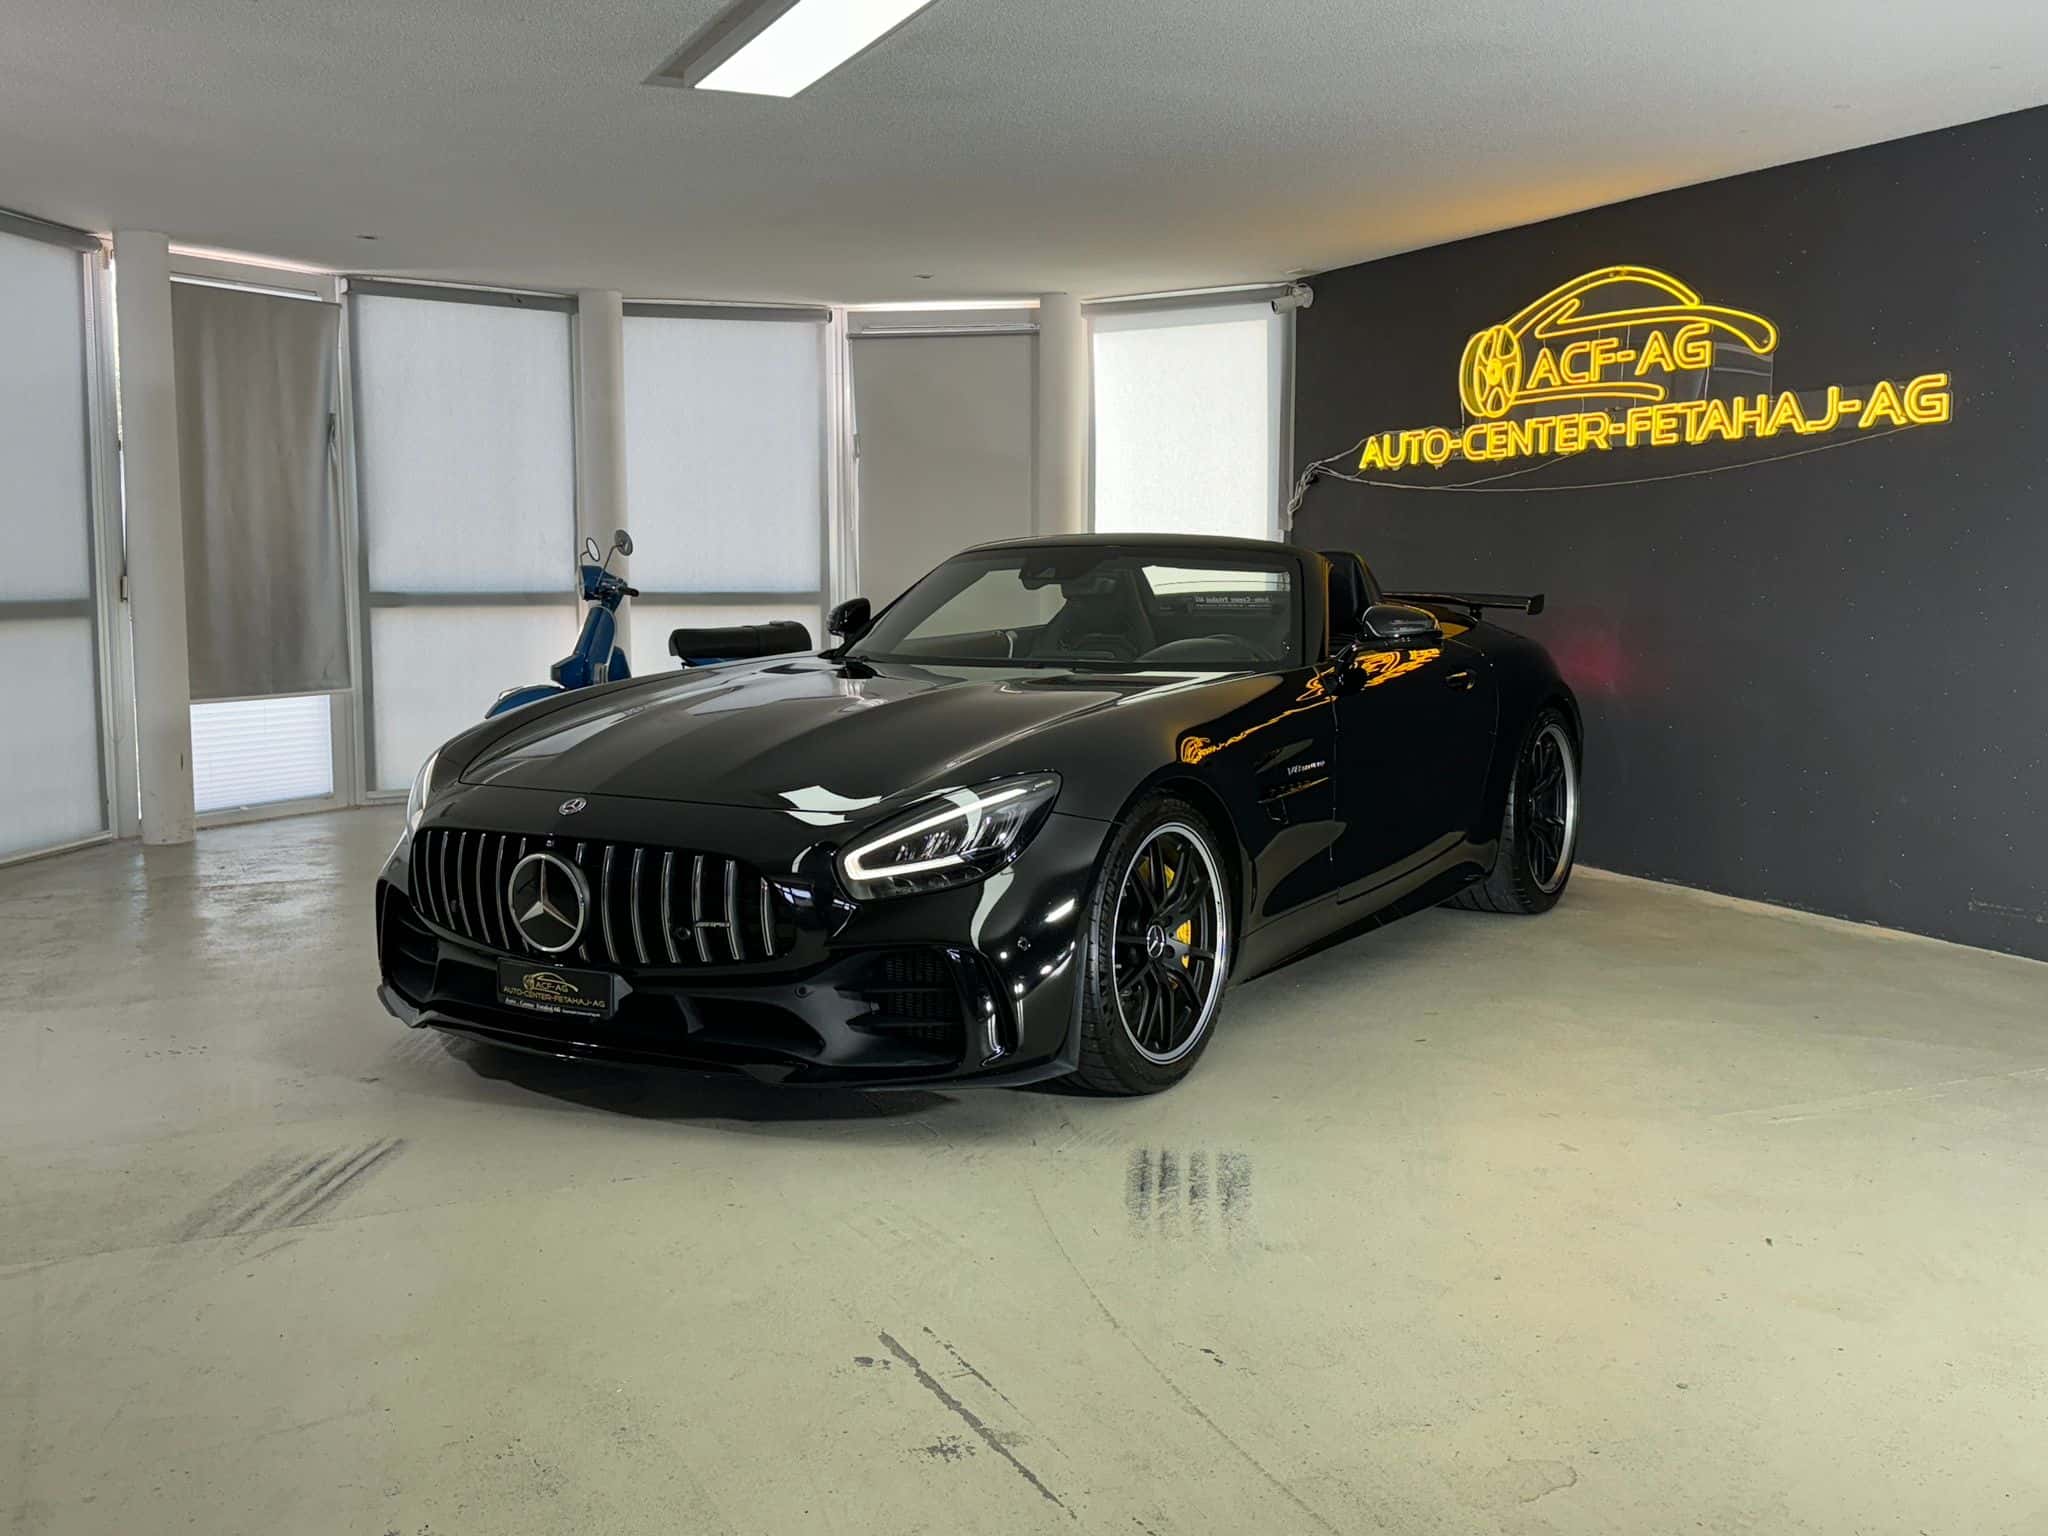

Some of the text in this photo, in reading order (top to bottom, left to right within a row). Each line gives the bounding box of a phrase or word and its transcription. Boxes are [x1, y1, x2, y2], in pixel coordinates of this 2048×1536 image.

[1526, 323, 1712, 390] ACF-AG
[1359, 373, 1950, 470] AUTO-CENTER-FETAHAJ-AG
[535, 980, 568, 993] ACF-AG
